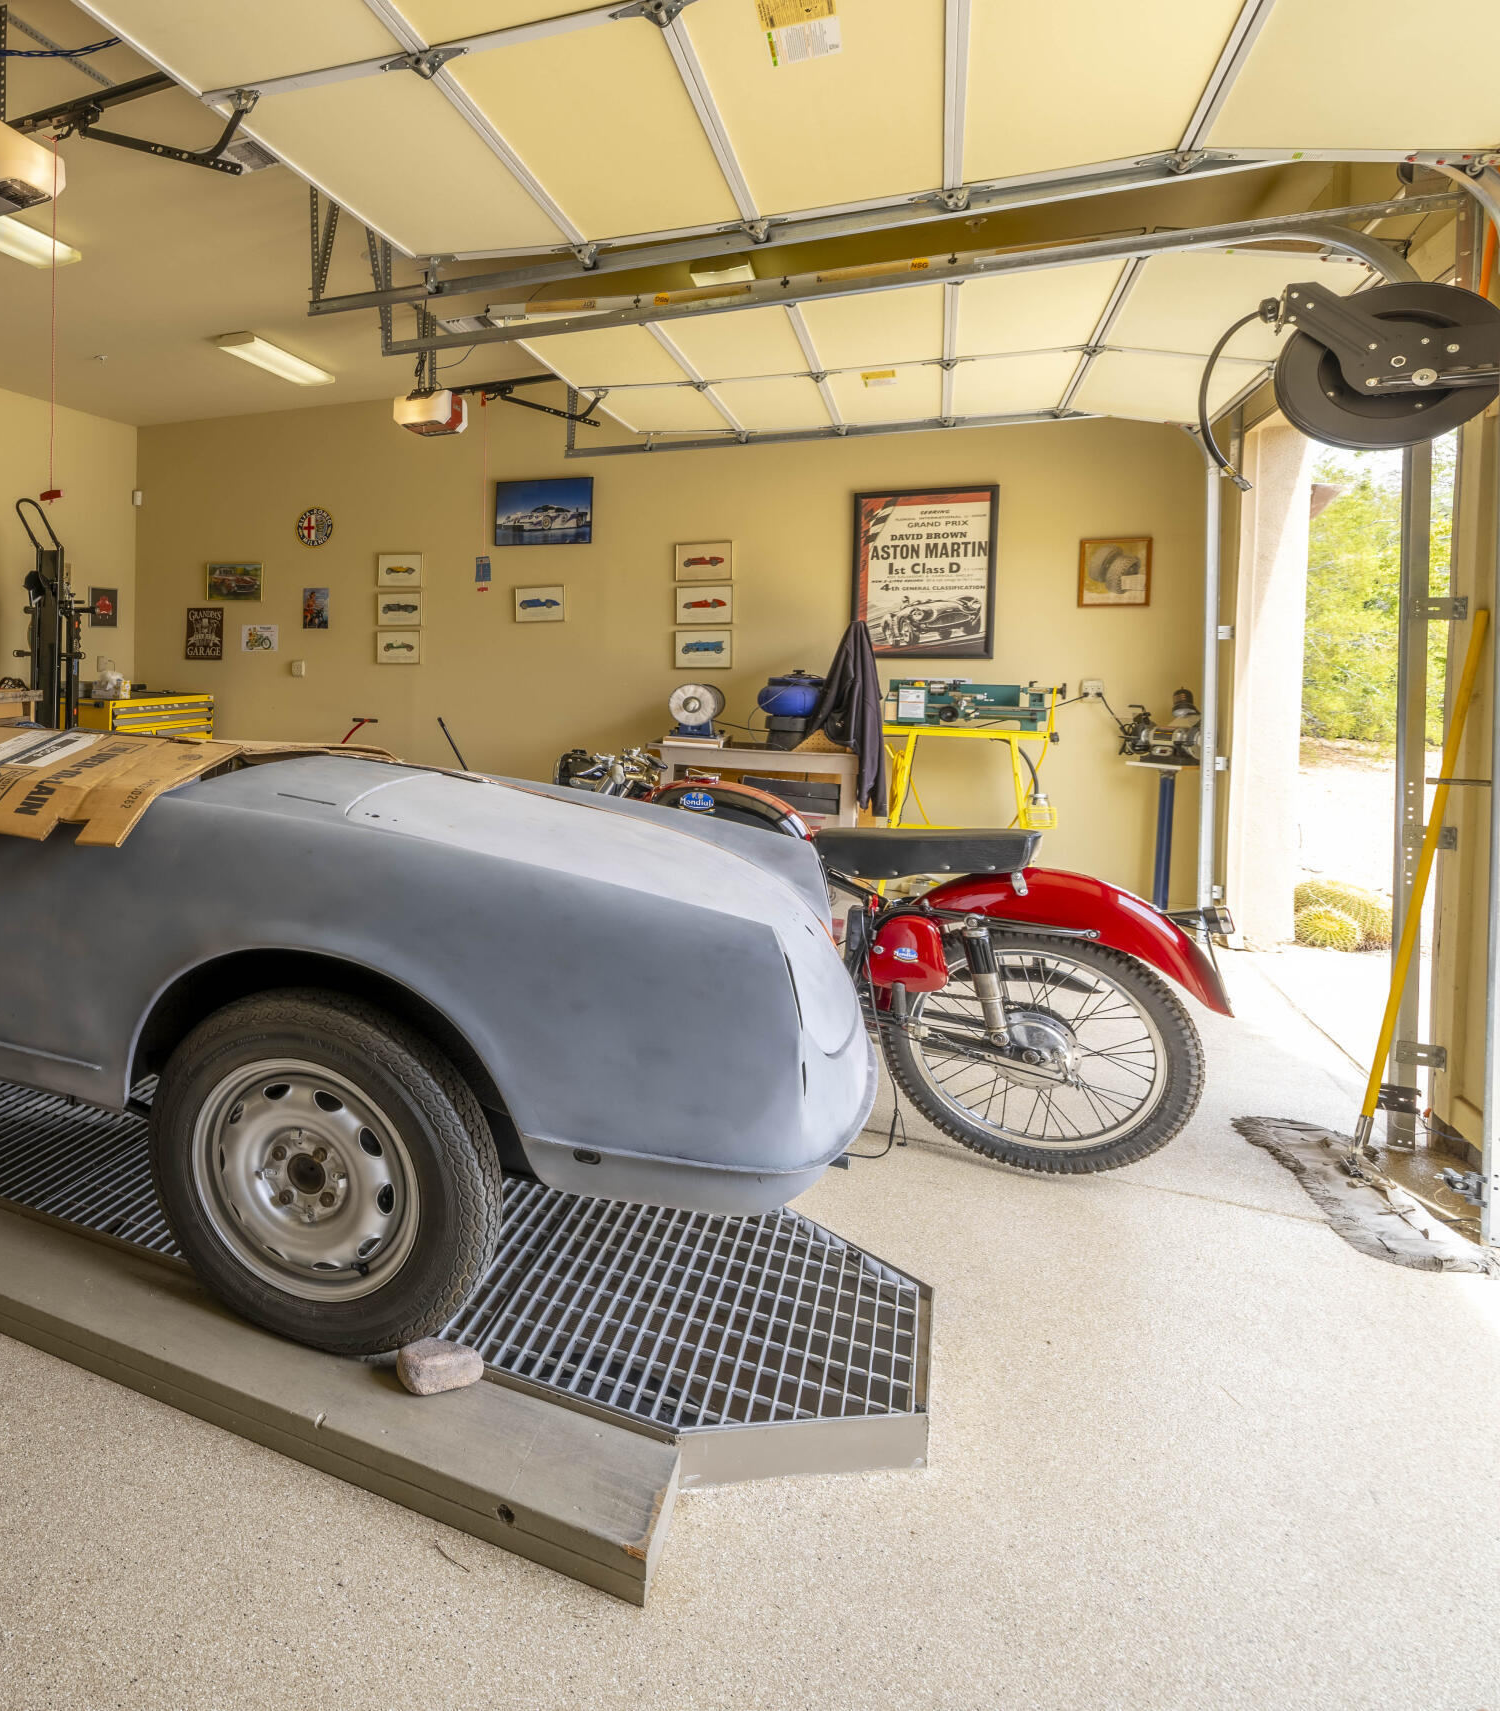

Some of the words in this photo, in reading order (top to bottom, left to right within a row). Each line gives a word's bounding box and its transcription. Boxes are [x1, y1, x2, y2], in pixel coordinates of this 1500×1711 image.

[890, 533, 923, 541] DAVID
[870, 544, 920, 560] ASTON
[925, 541, 989, 558] MARTIN
[911, 561, 945, 574] Class
[948, 562, 961, 574] D
[187, 646, 221, 656] GARAGE
[680, 797, 714, 807] Mondial
